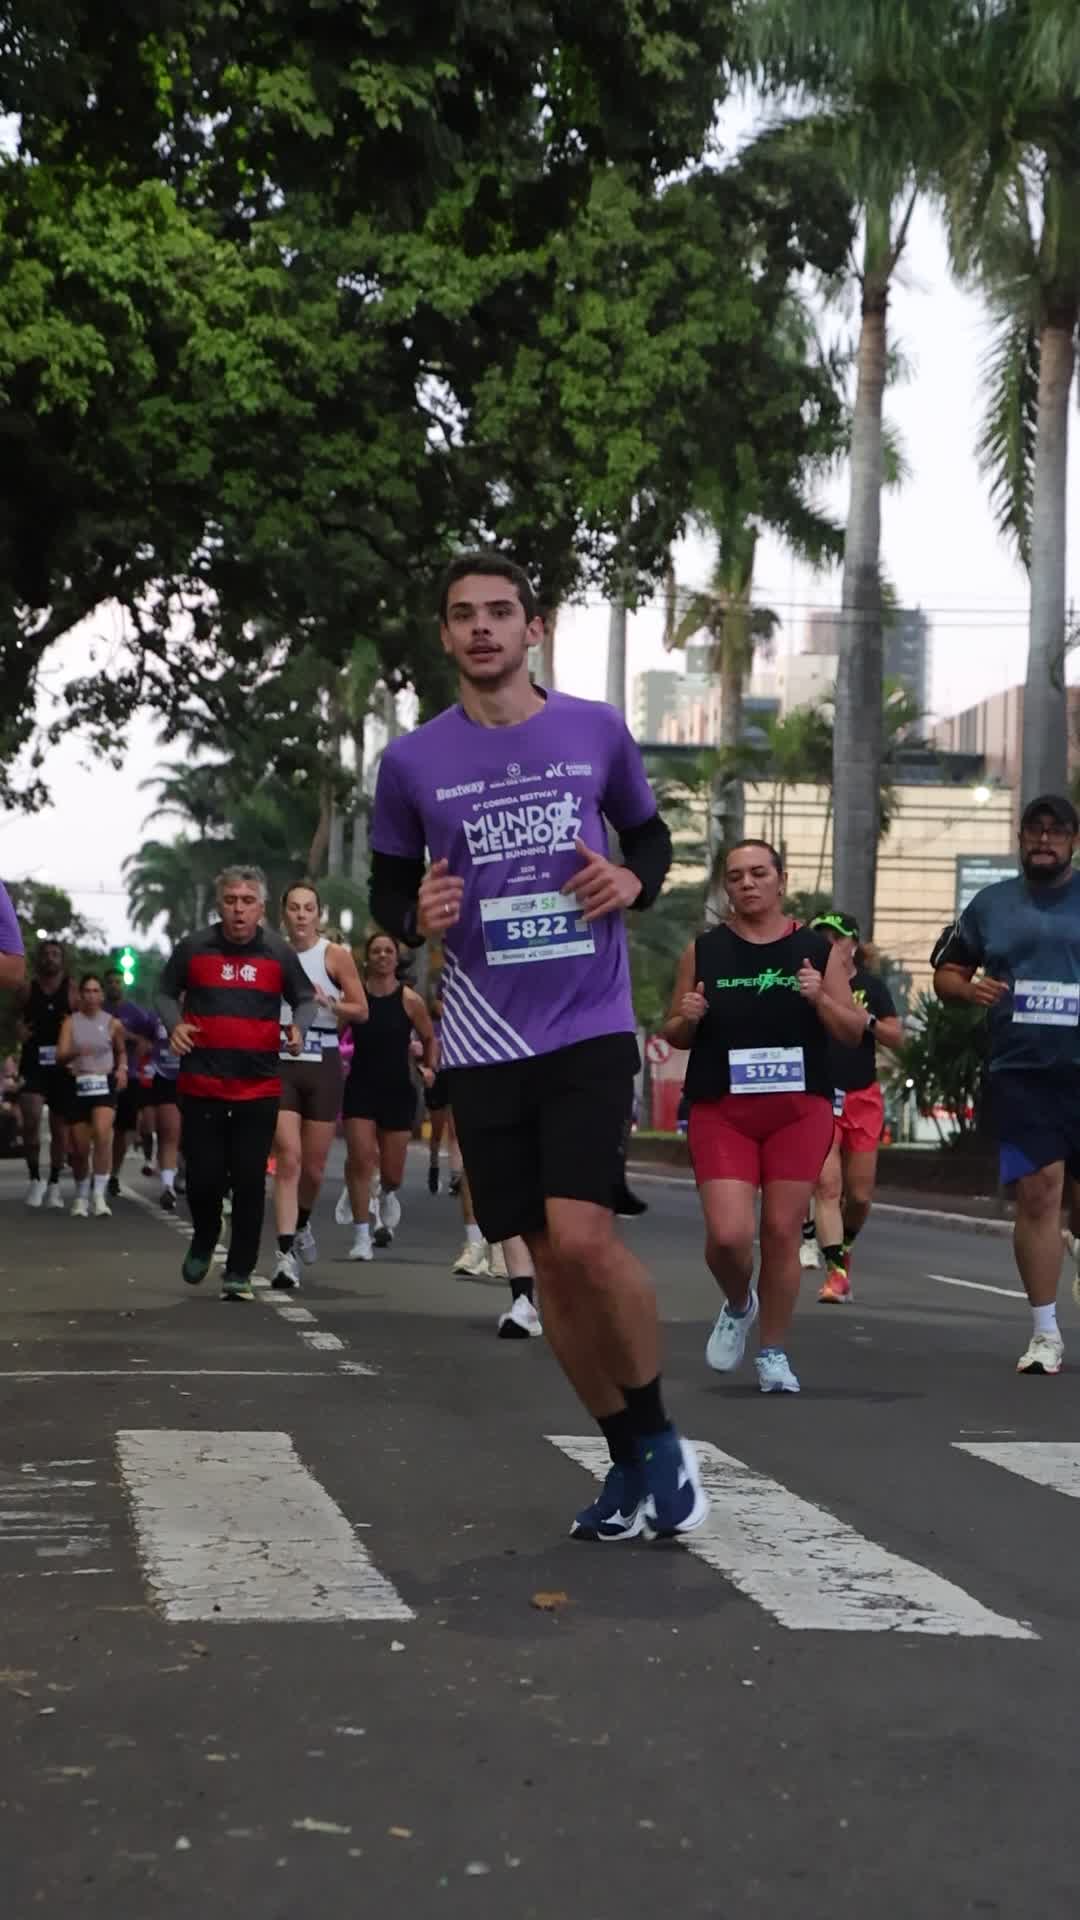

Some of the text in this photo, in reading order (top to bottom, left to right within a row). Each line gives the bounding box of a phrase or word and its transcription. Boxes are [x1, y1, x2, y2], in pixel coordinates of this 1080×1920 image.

[520, 789, 558, 802] BESTWAY
[462, 802, 562, 840] MUNDO
[467, 822, 567, 855] MELHOR
[505, 845, 546, 859] RUNNING
[506, 916, 568, 940] 5822
[745, 1063, 788, 1079] 5174
